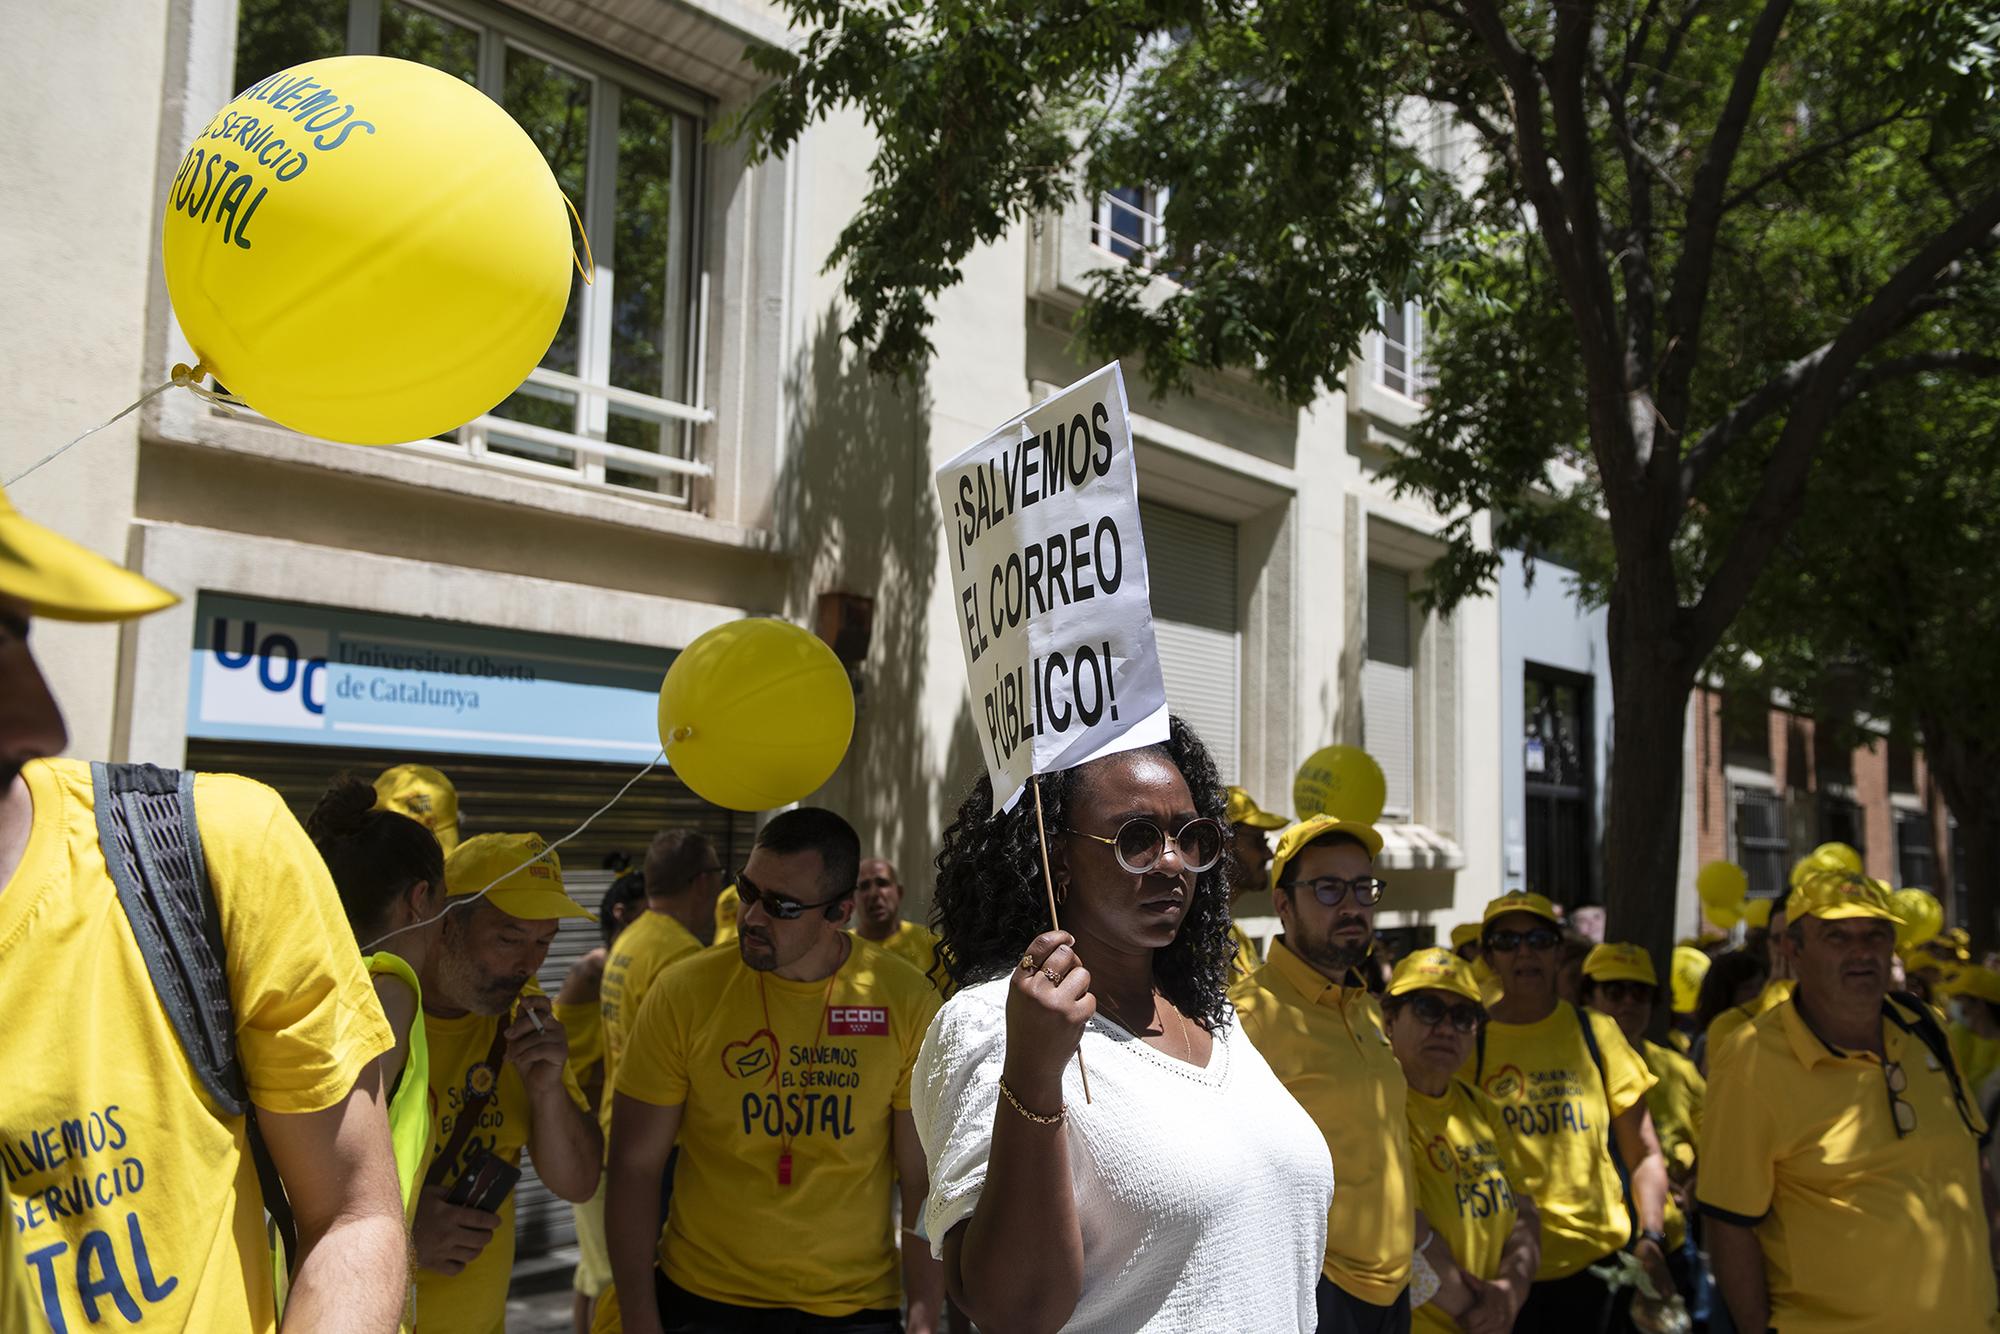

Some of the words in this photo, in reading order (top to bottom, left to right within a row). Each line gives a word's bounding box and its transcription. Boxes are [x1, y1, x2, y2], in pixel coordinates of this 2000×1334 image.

[211, 111, 308, 182] SERVICIO
[954, 401, 1113, 572] ¡SALVEMOS
[962, 582, 989, 664] EL
[989, 515, 1123, 639] CORREO
[338, 641, 464, 678] Universitat
[466, 655, 537, 683] Oberta
[336, 673, 366, 700] de
[369, 675, 480, 714] Catalunya
[984, 640, 1119, 770] PÚBLICO!
[831, 1009, 886, 1023] CCOO
[789, 1045, 858, 1068] SALVEMOS
[781, 1072, 796, 1088] EL
[799, 1071, 860, 1089] SERVICIO
[742, 1092, 856, 1141] POSTAL
[1503, 1101, 1590, 1136] POSTAL
